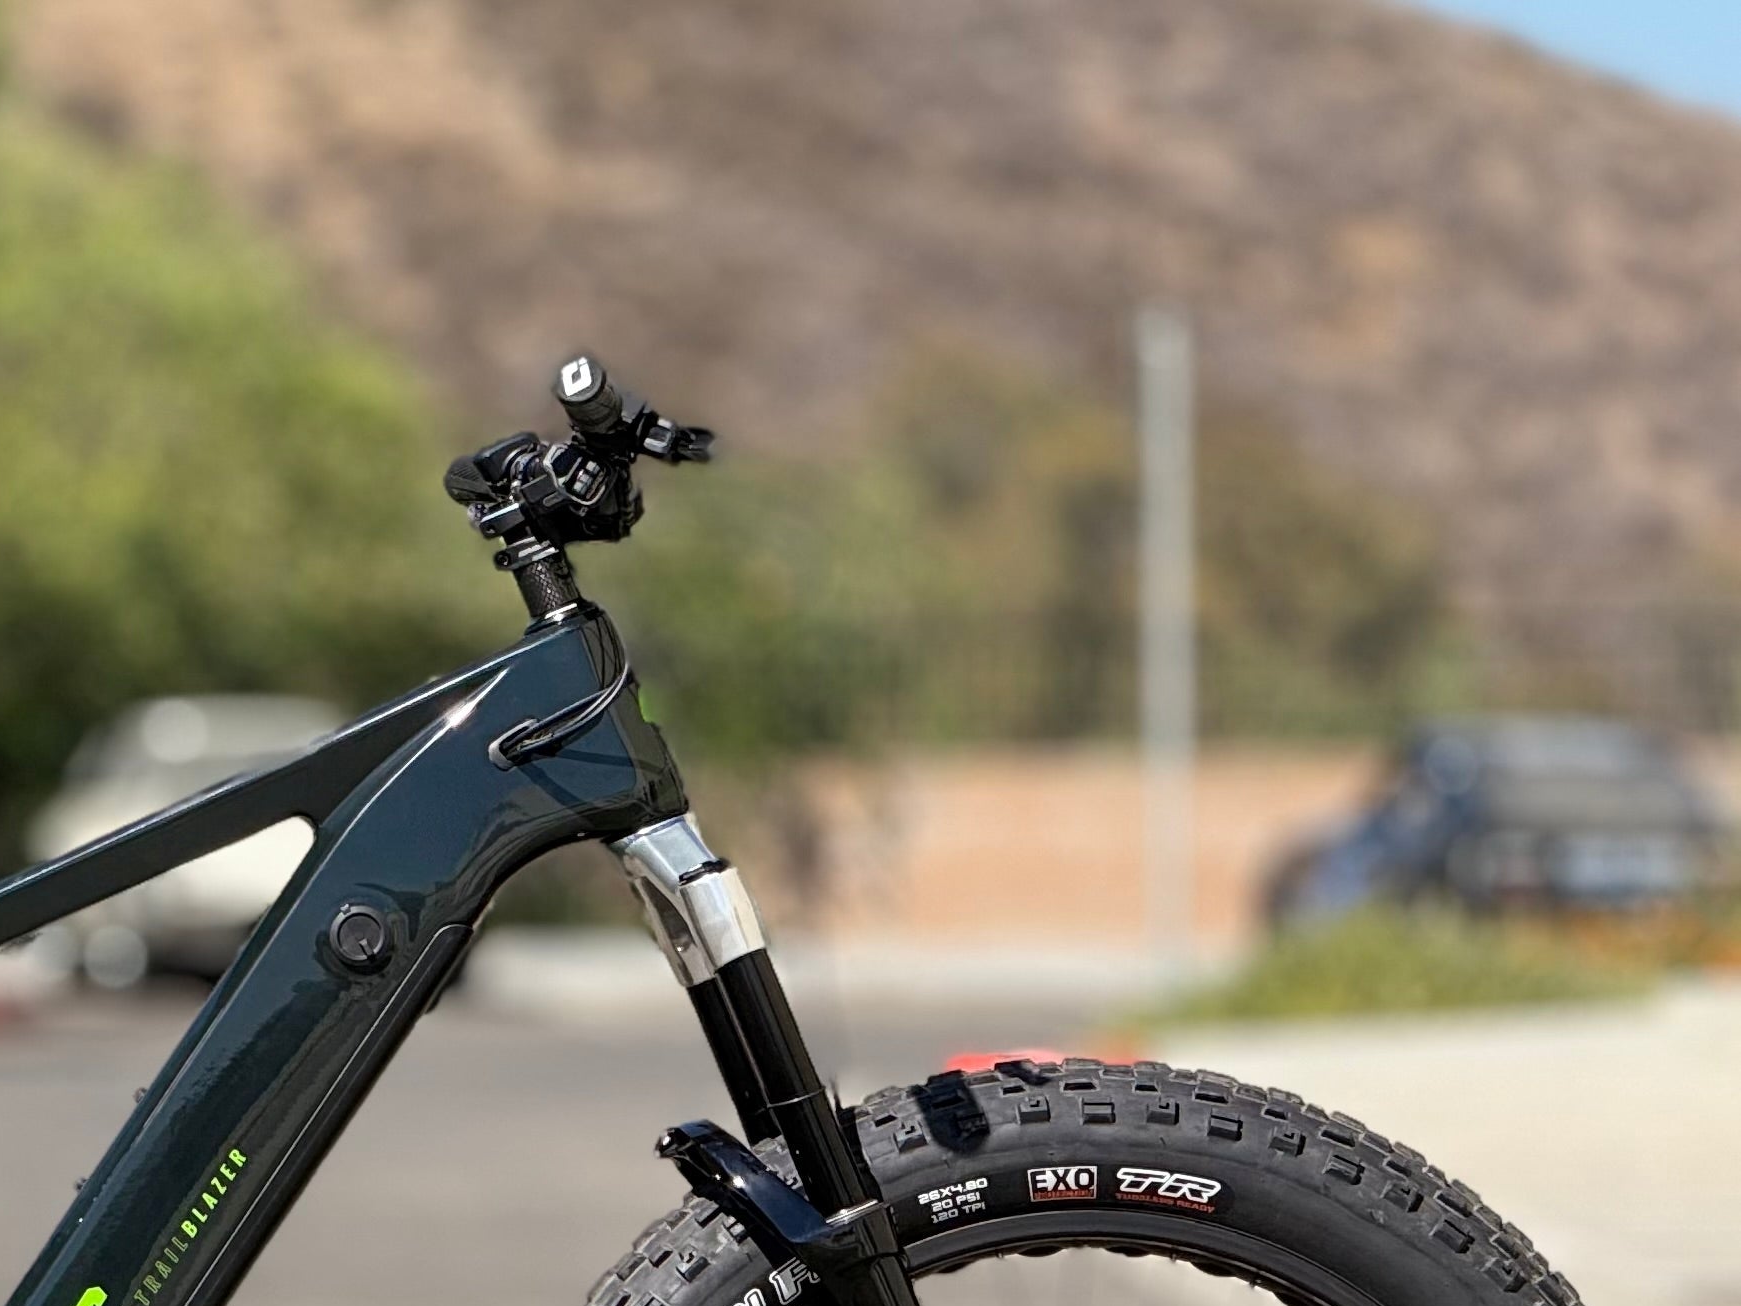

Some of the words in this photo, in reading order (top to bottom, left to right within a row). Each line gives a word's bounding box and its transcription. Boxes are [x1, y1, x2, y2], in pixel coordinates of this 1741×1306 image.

[1030, 1168, 1095, 1191] EXO
[1116, 1167, 1222, 1204] TR
[930, 1208, 959, 1224] 120
[961, 1201, 986, 1214] TPI
[931, 1198, 953, 1213] 20
[955, 1191, 981, 1206] PSI
